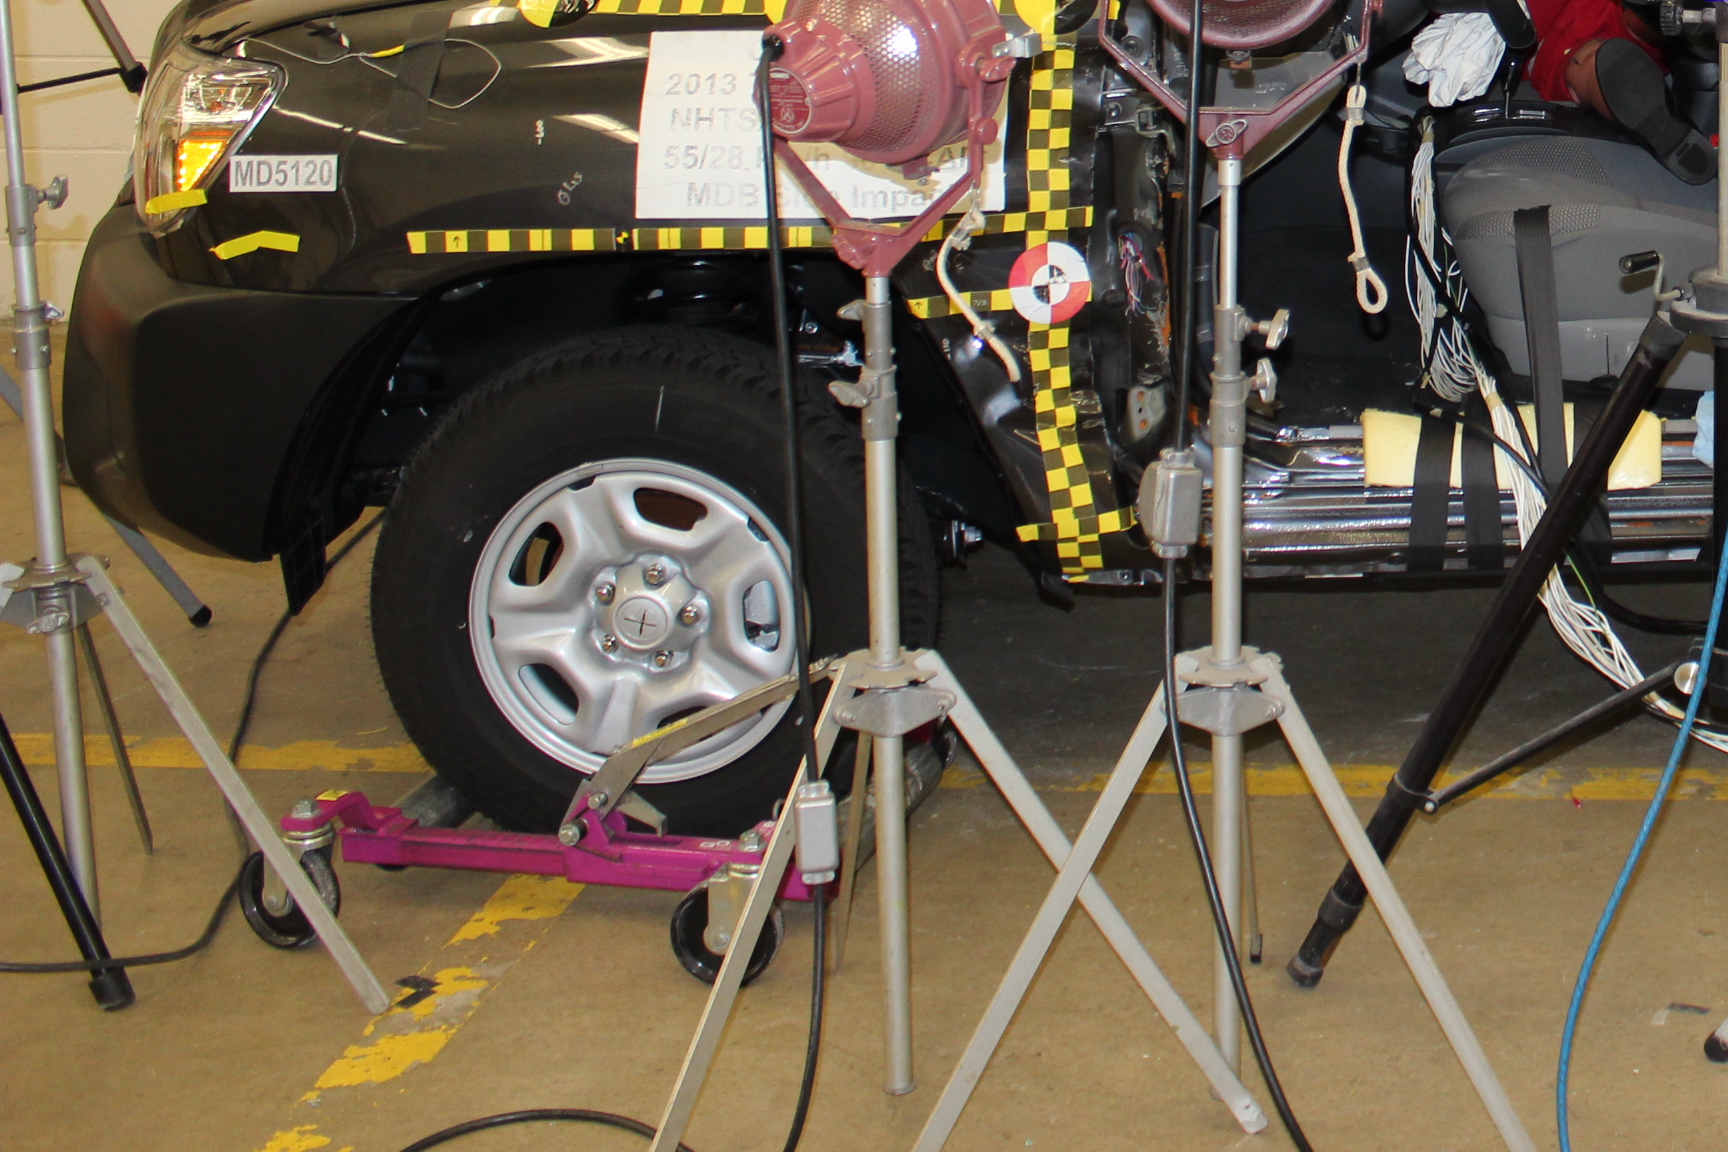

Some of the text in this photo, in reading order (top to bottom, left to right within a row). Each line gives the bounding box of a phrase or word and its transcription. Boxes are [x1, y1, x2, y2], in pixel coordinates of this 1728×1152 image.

[665, 72, 737, 96] 2013
[670, 107, 763, 132] NHTS
[234, 159, 333, 187] MD5120
[686, 182, 759, 208] MDB
[852, 183, 954, 214] Impa
